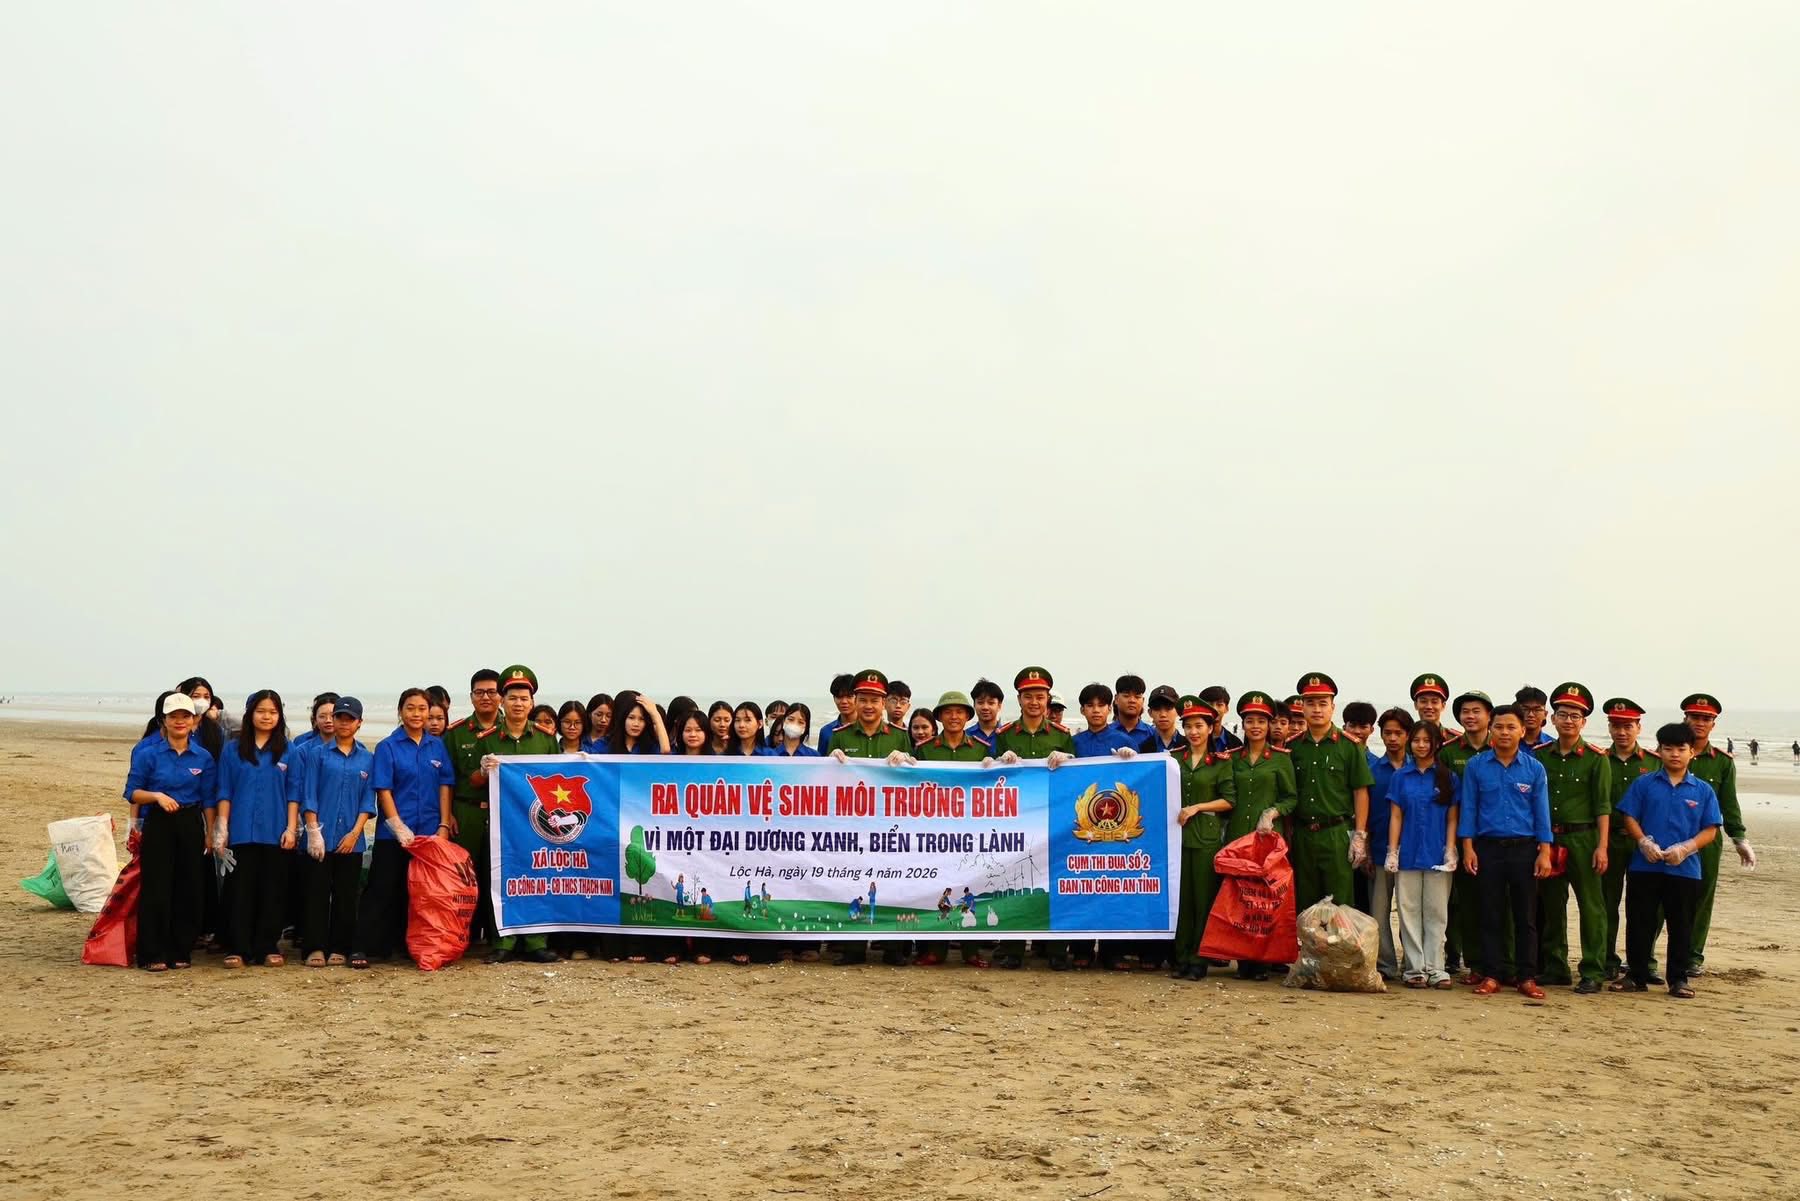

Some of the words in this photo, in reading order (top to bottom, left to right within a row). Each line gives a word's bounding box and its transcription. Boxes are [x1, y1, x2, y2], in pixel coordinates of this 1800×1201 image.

[652, 783, 679, 816] RA
[685, 778, 741, 818] QUÂN
[748, 780, 773, 822] VỆ
[779, 785, 828, 816] SINH
[835, 781, 876, 817] MÔI
[882, 782, 965, 818] TRƯỜNG
[971, 776, 1018, 818] BIỂN
[644, 826, 661, 851] VÌ
[666, 826, 705, 856] MỘT
[709, 830, 740, 856] ĐẠI
[745, 829, 806, 852] DƯƠNG
[811, 831, 864, 855] XANH,
[869, 824, 911, 853] BIỂN
[916, 833, 973, 853] TRONG
[979, 828, 1025, 853] LÀNH
[533, 848, 547, 868] XÃ
[550, 849, 570, 871] LỘC
[572, 850, 588, 868] HÀ
[1068, 855, 1089, 873] CỤM
[1091, 855, 1106, 869] THI
[1108, 855, 1126, 869] ĐUA
[1128, 850, 1142, 870] SỐ
[1143, 855, 1149, 869] 2
[729, 865, 751, 877] Lộc
[755, 866, 775, 879] Hà,
[778, 867, 808, 880] ngày
[811, 867, 824, 877] 19
[827, 867, 862, 881] tháng
[864, 868, 873, 879] 4
[876, 868, 902, 879] năm
[905, 867, 938, 879] 2026
[1059, 879, 1078, 894] BAN
[1081, 879, 1092, 893] TN
[1095, 876, 1121, 893] CÔNG
[1122, 879, 1136, 893] AN
[1137, 874, 1159, 893] TỈNH
[518, 876, 535, 895] CÔNG
[536, 879, 546, 894] AN
[561, 878, 578, 894] THCS
[579, 878, 599, 898] THẠCH
[600, 879, 613, 895] KIM
